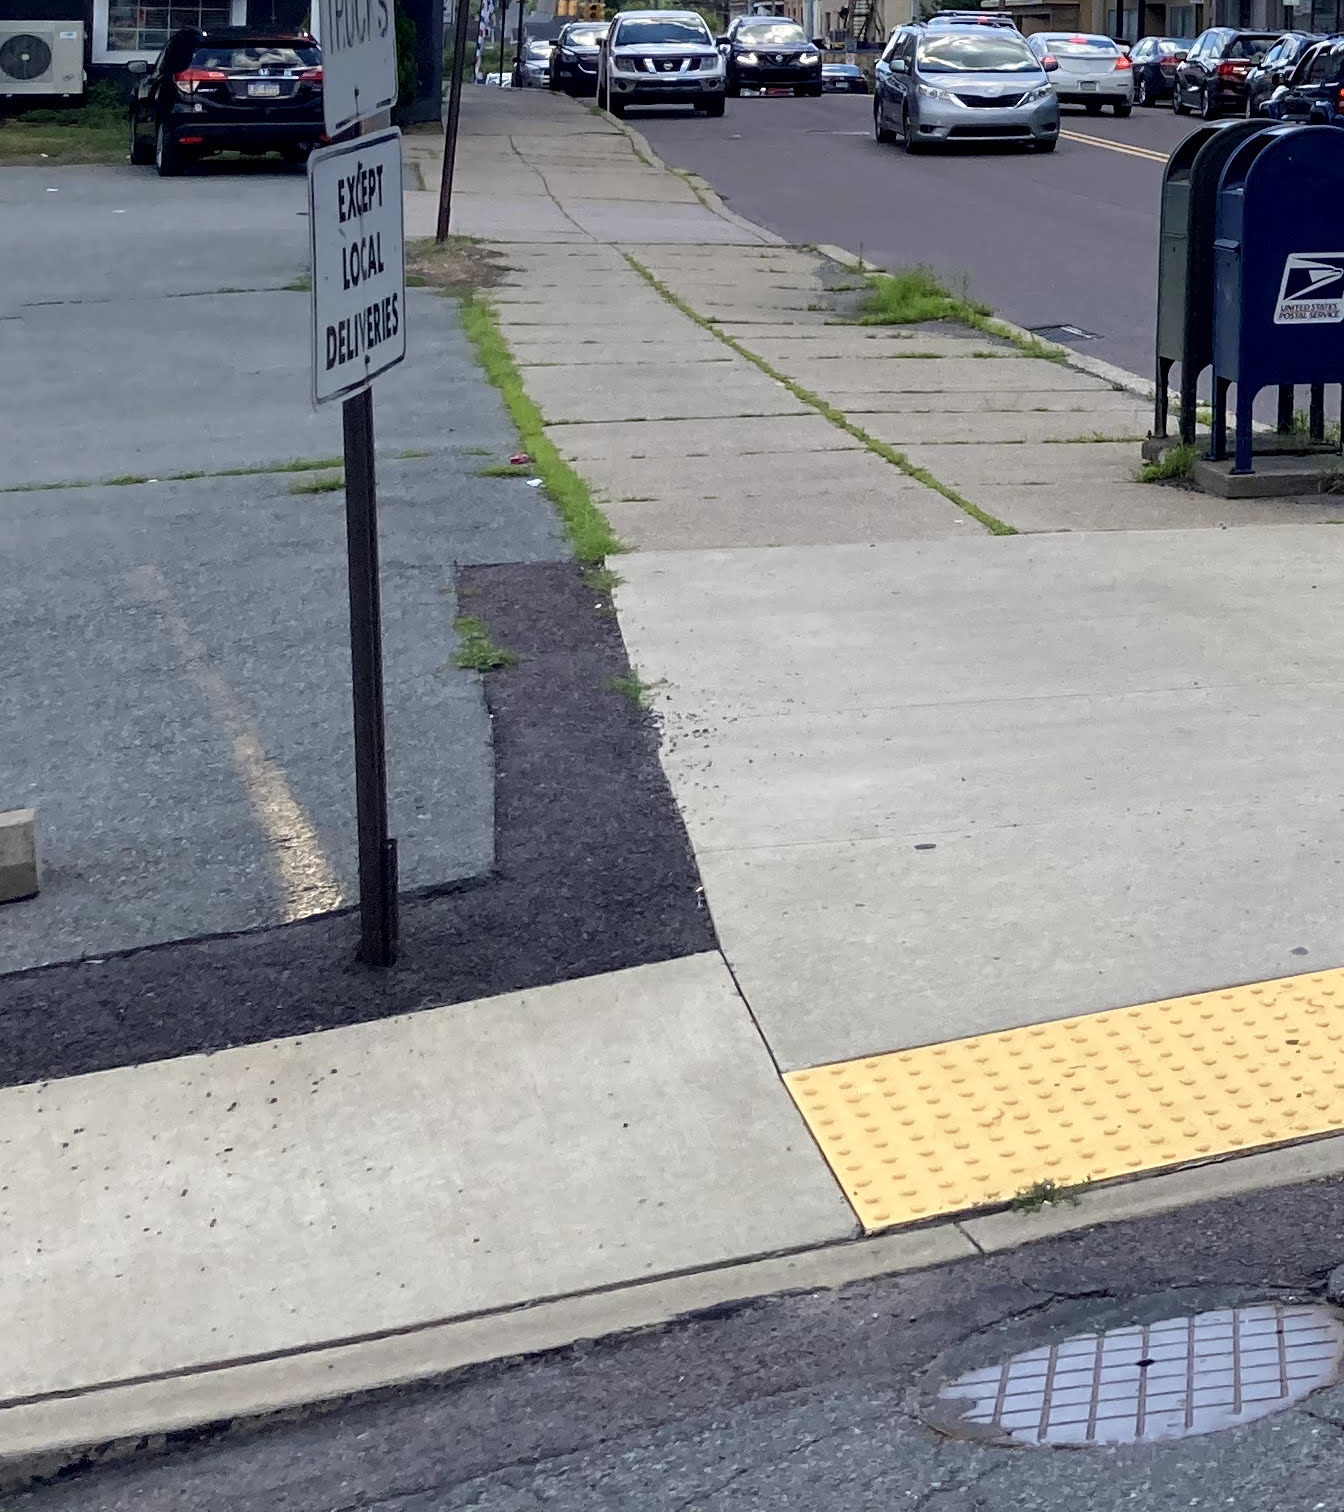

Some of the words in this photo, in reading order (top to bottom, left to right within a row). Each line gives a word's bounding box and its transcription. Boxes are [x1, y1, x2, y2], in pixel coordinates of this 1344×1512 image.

[338, 164, 384, 224] EXCEPT
[342, 232, 385, 291] LOCAL
[326, 292, 399, 371] DELIVERIES
[1279, 311, 1307, 319] POSTAL
[1310, 310, 1341, 318] SERVICE
[1281, 304, 1310, 312] UNITED
[1311, 303, 1337, 311] STATES
